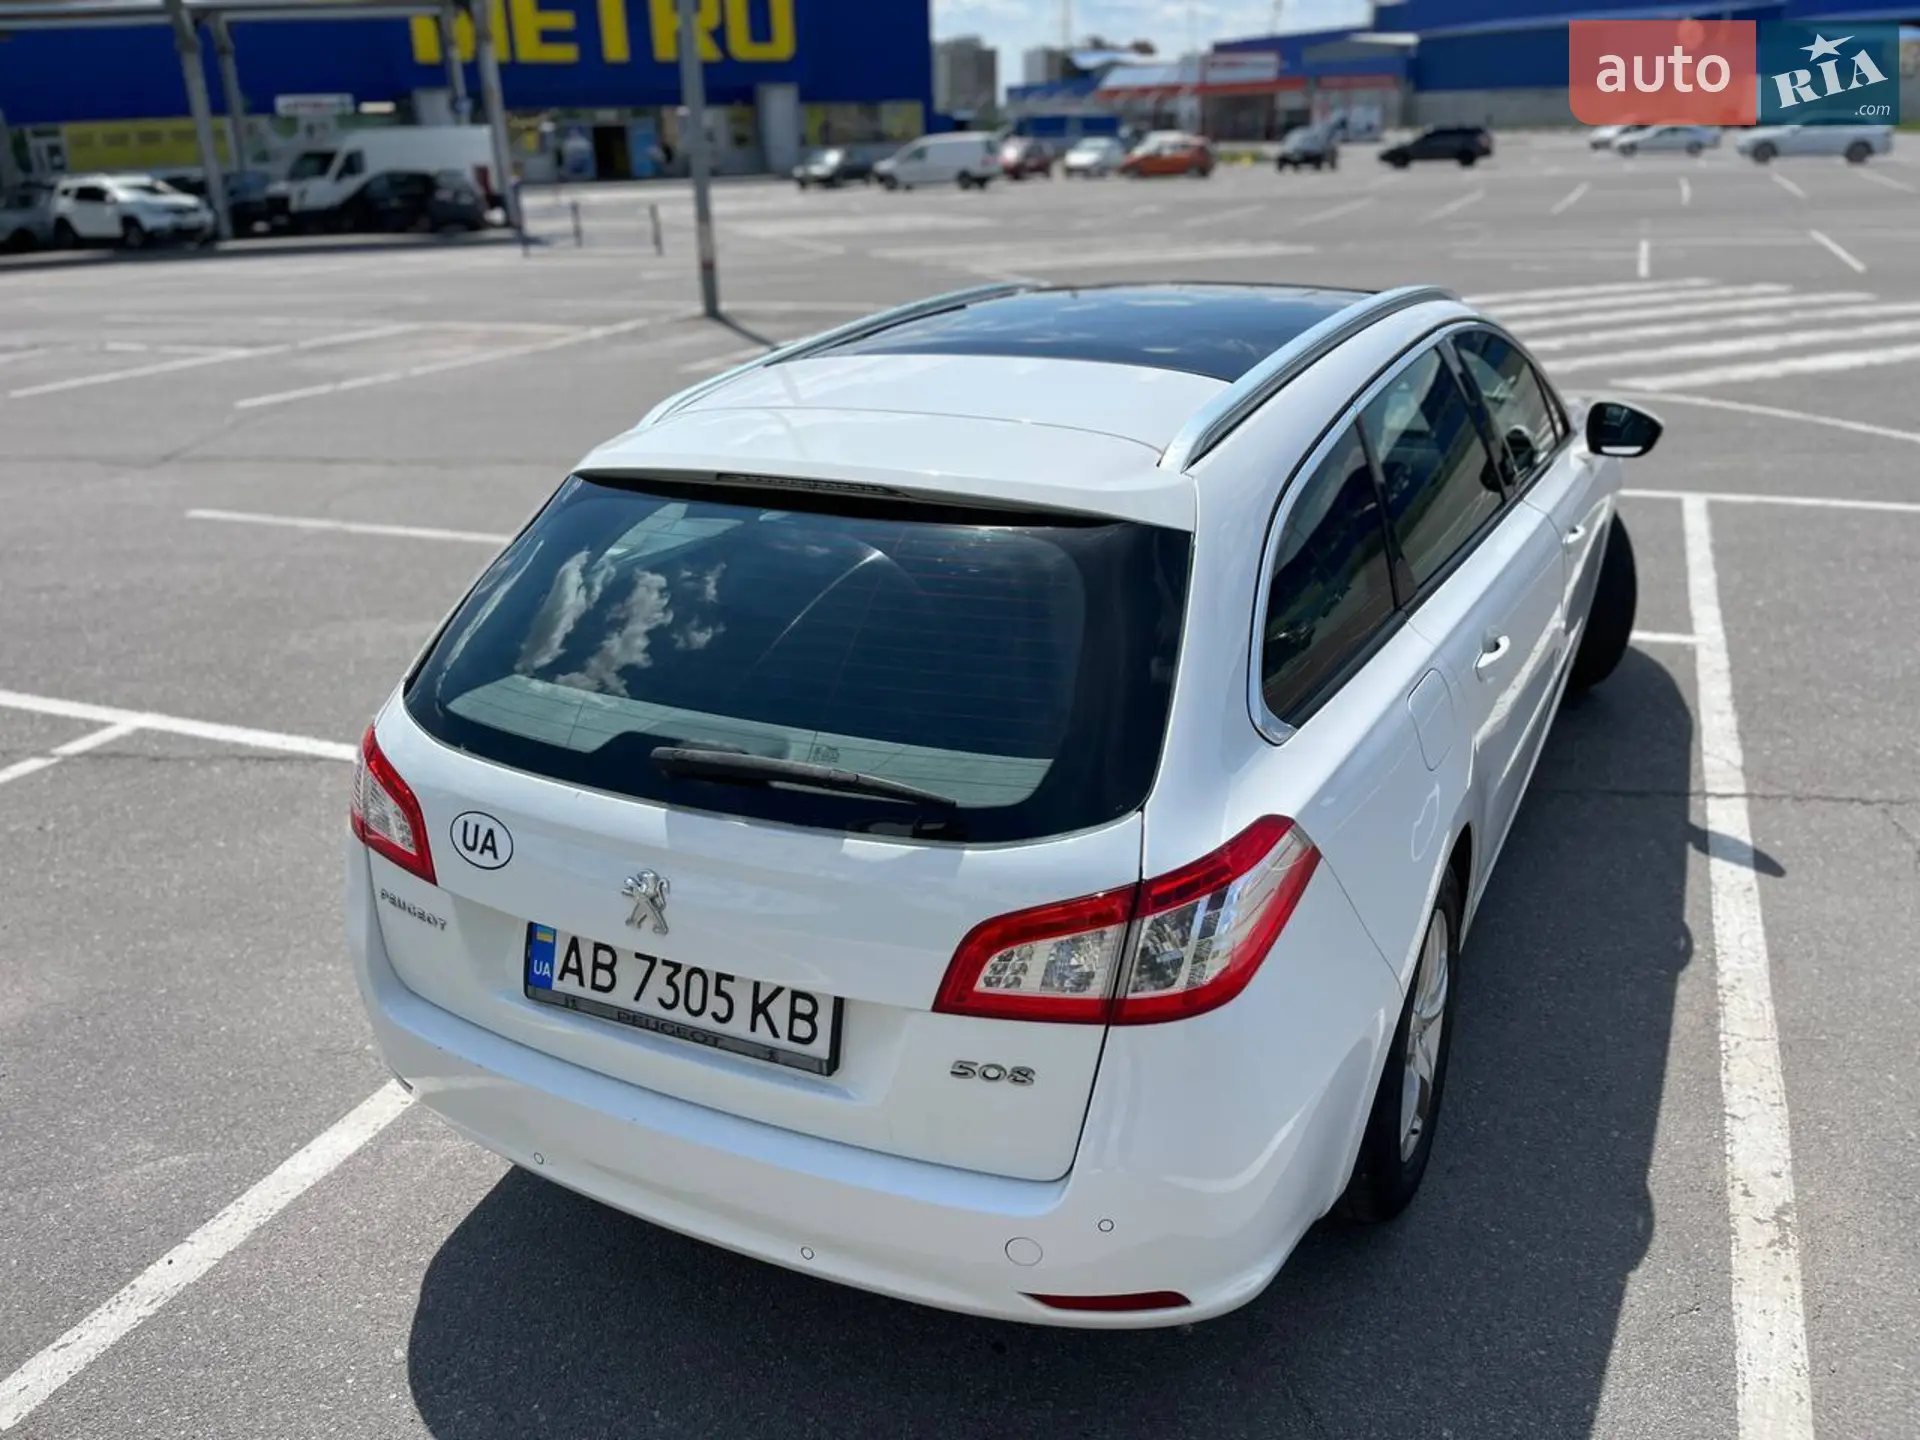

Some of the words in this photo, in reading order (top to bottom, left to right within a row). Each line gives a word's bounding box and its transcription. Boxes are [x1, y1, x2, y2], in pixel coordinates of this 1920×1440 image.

[461, 820, 499, 860] UA
[380, 888, 447, 931] PEUGEOT
[533, 959, 552, 977] UA
[557, 935, 618, 993] AB
[633, 951, 735, 1025] 7305
[750, 980, 819, 1045] KB
[617, 1010, 724, 1048] PEUGEOT
[949, 1060, 1036, 1086] 508
